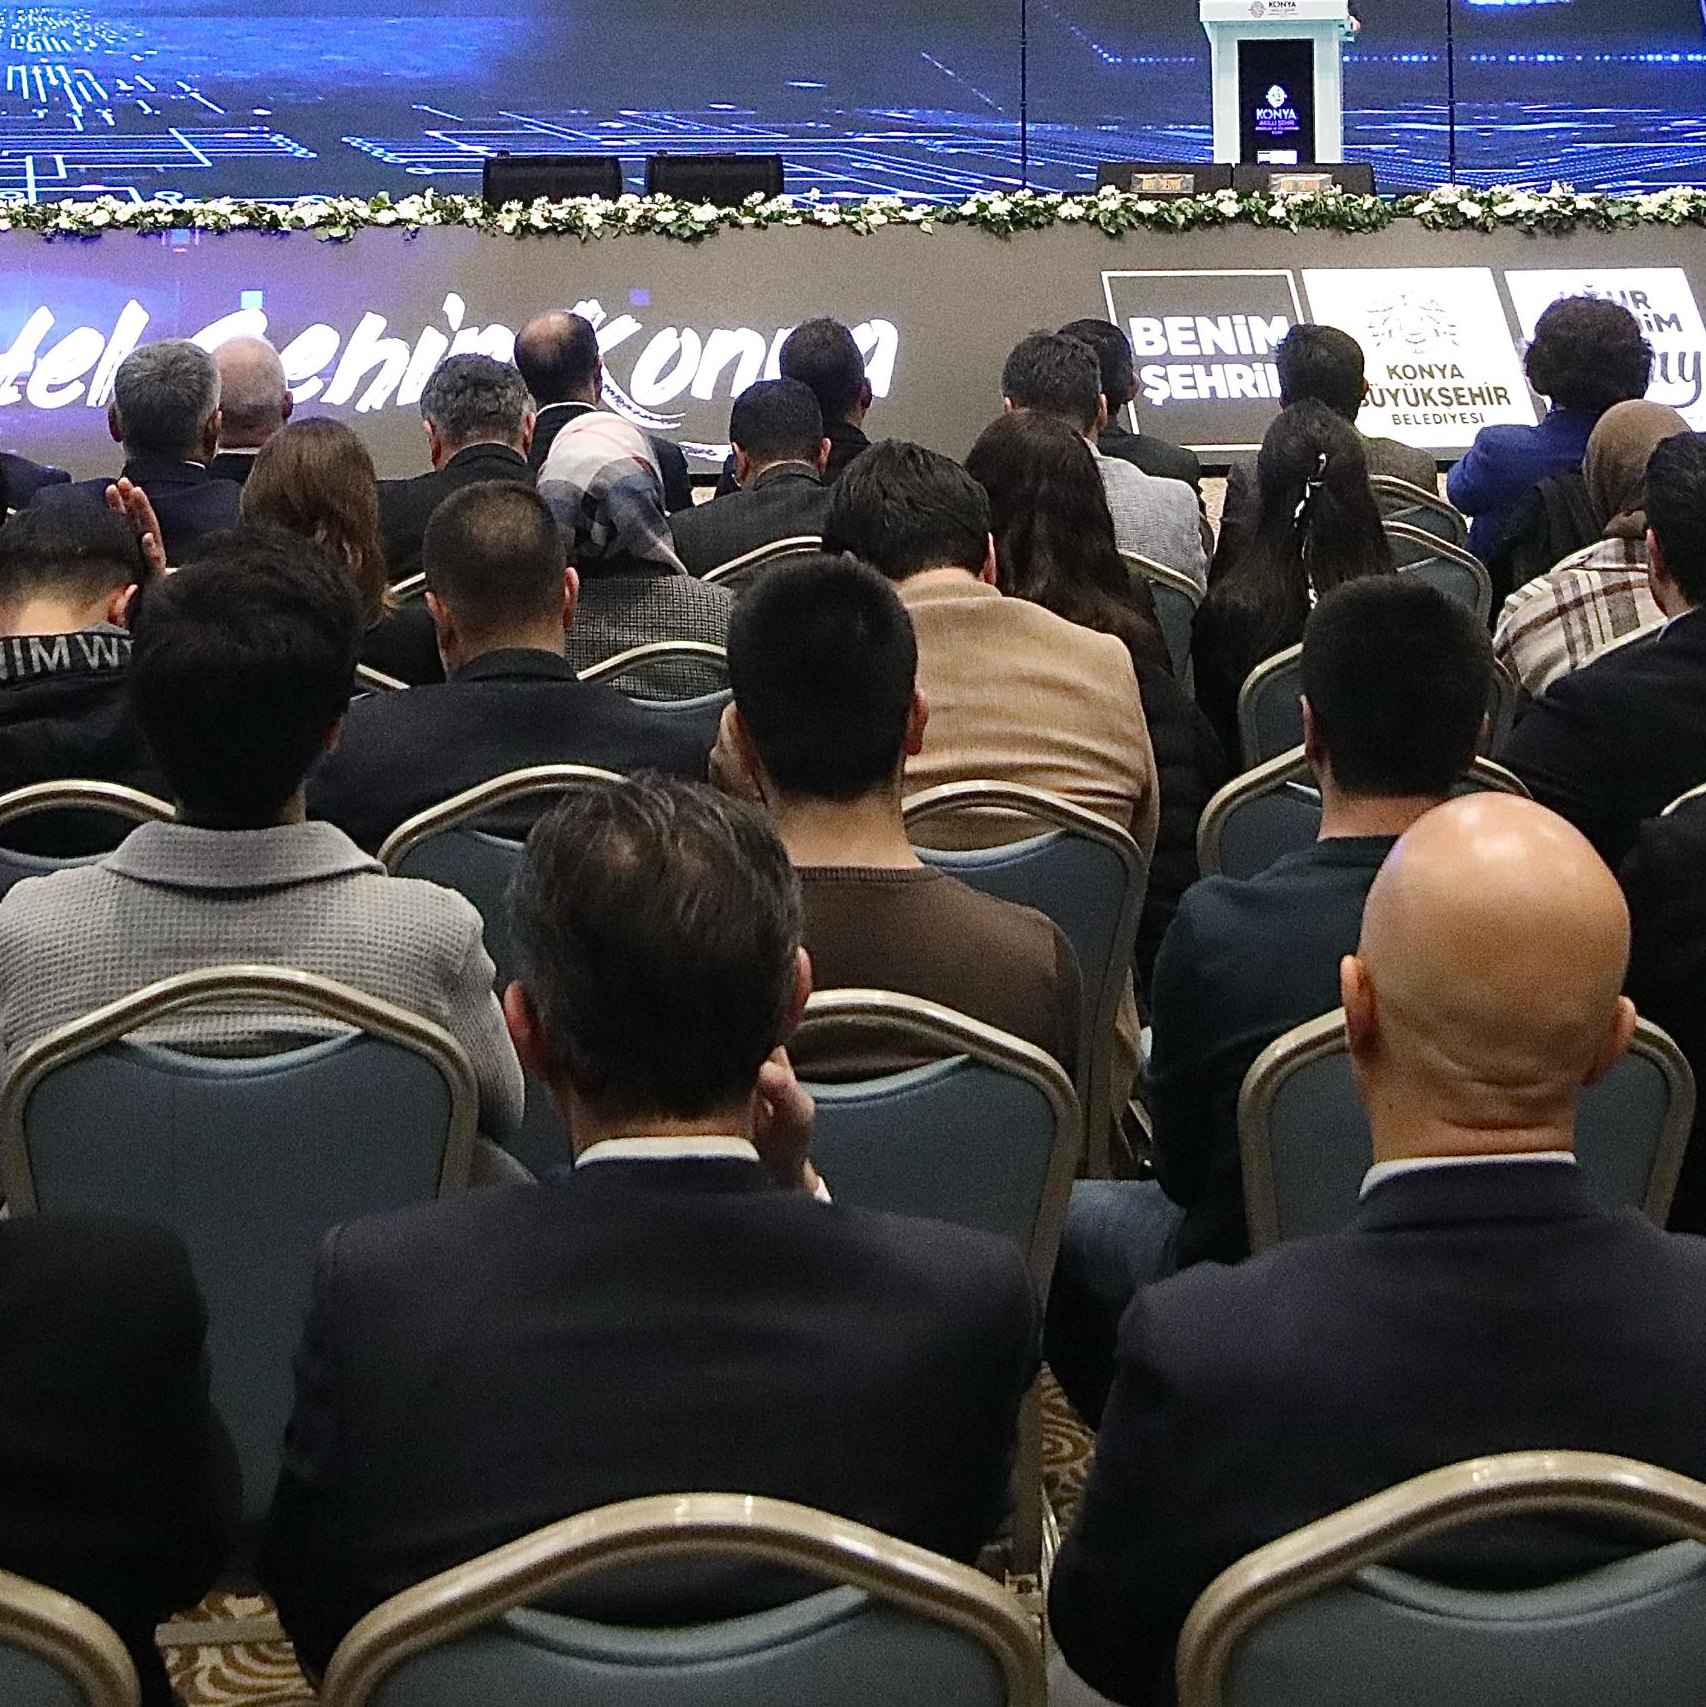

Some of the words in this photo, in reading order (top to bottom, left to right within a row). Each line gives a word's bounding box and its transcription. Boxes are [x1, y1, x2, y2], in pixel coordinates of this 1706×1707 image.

[1256, 108, 1297, 120] KONYA
[570, 298, 899, 461] Kona
[1386, 364, 1465, 380] KONYA
